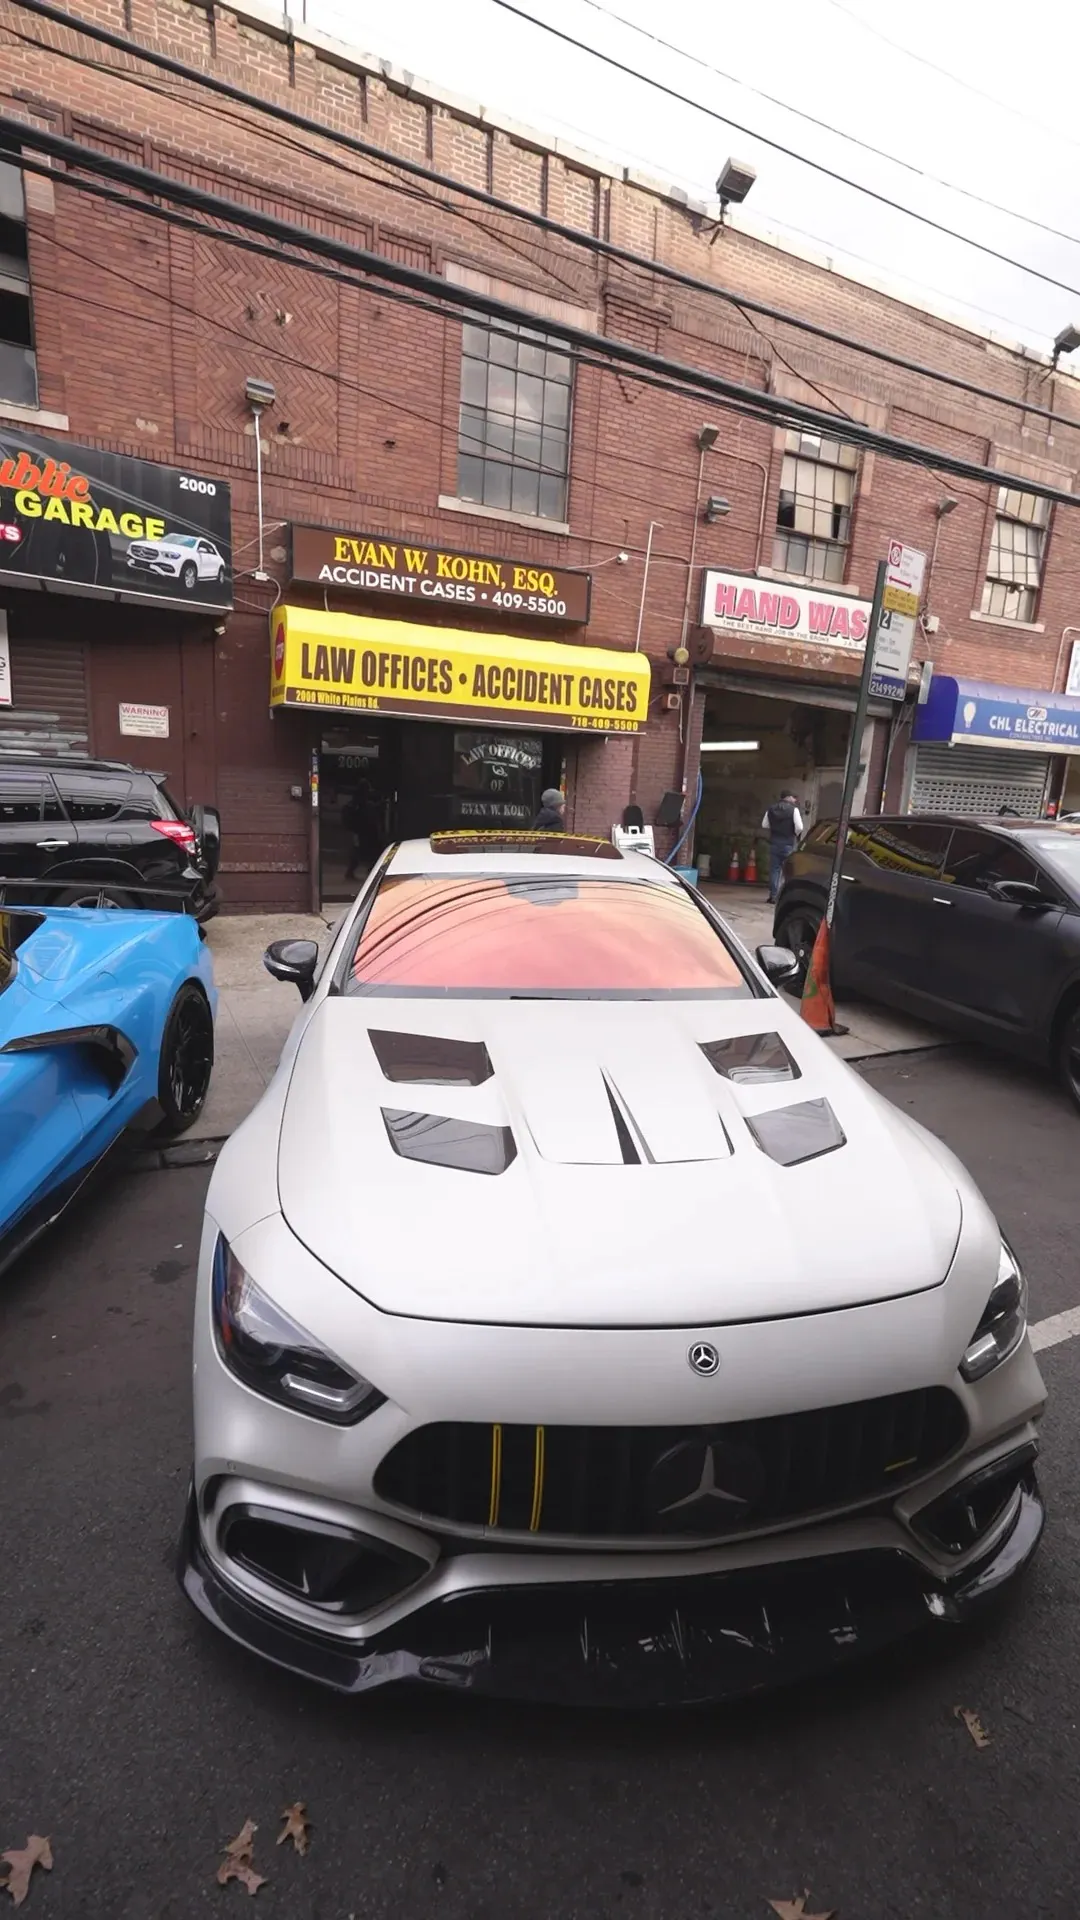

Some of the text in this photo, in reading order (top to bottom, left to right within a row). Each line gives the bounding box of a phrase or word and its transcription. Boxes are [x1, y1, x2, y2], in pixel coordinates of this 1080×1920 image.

[179, 476, 217, 497] 2000
[15, 490, 165, 542] GARAGE
[334, 537, 559, 598] EVAN W. KOHN, ESQ.
[318, 564, 567, 616] ACCIDENT CASES 409-5500
[714, 583, 801, 630] HAND
[808, 600, 870, 643] WAS
[881, 611, 890, 627] 2
[301, 642, 356, 685] LAW
[361, 650, 454, 695] OFFICES
[472, 664, 575, 706] ACCIDENT
[578, 676, 638, 713] CASES
[295, 689, 317, 703] 2000
[317, 691, 341, 706] White
[341, 694, 367, 709] Plains
[122, 706, 166, 718] WARNING
[571, 716, 639, 732] 718-409-5500
[989, 715, 1079, 739] CHL ELECTRICAL
[460, 744, 487, 766] LAW
[490, 780, 505, 792] OF
[461, 802, 488, 816] EVAN
